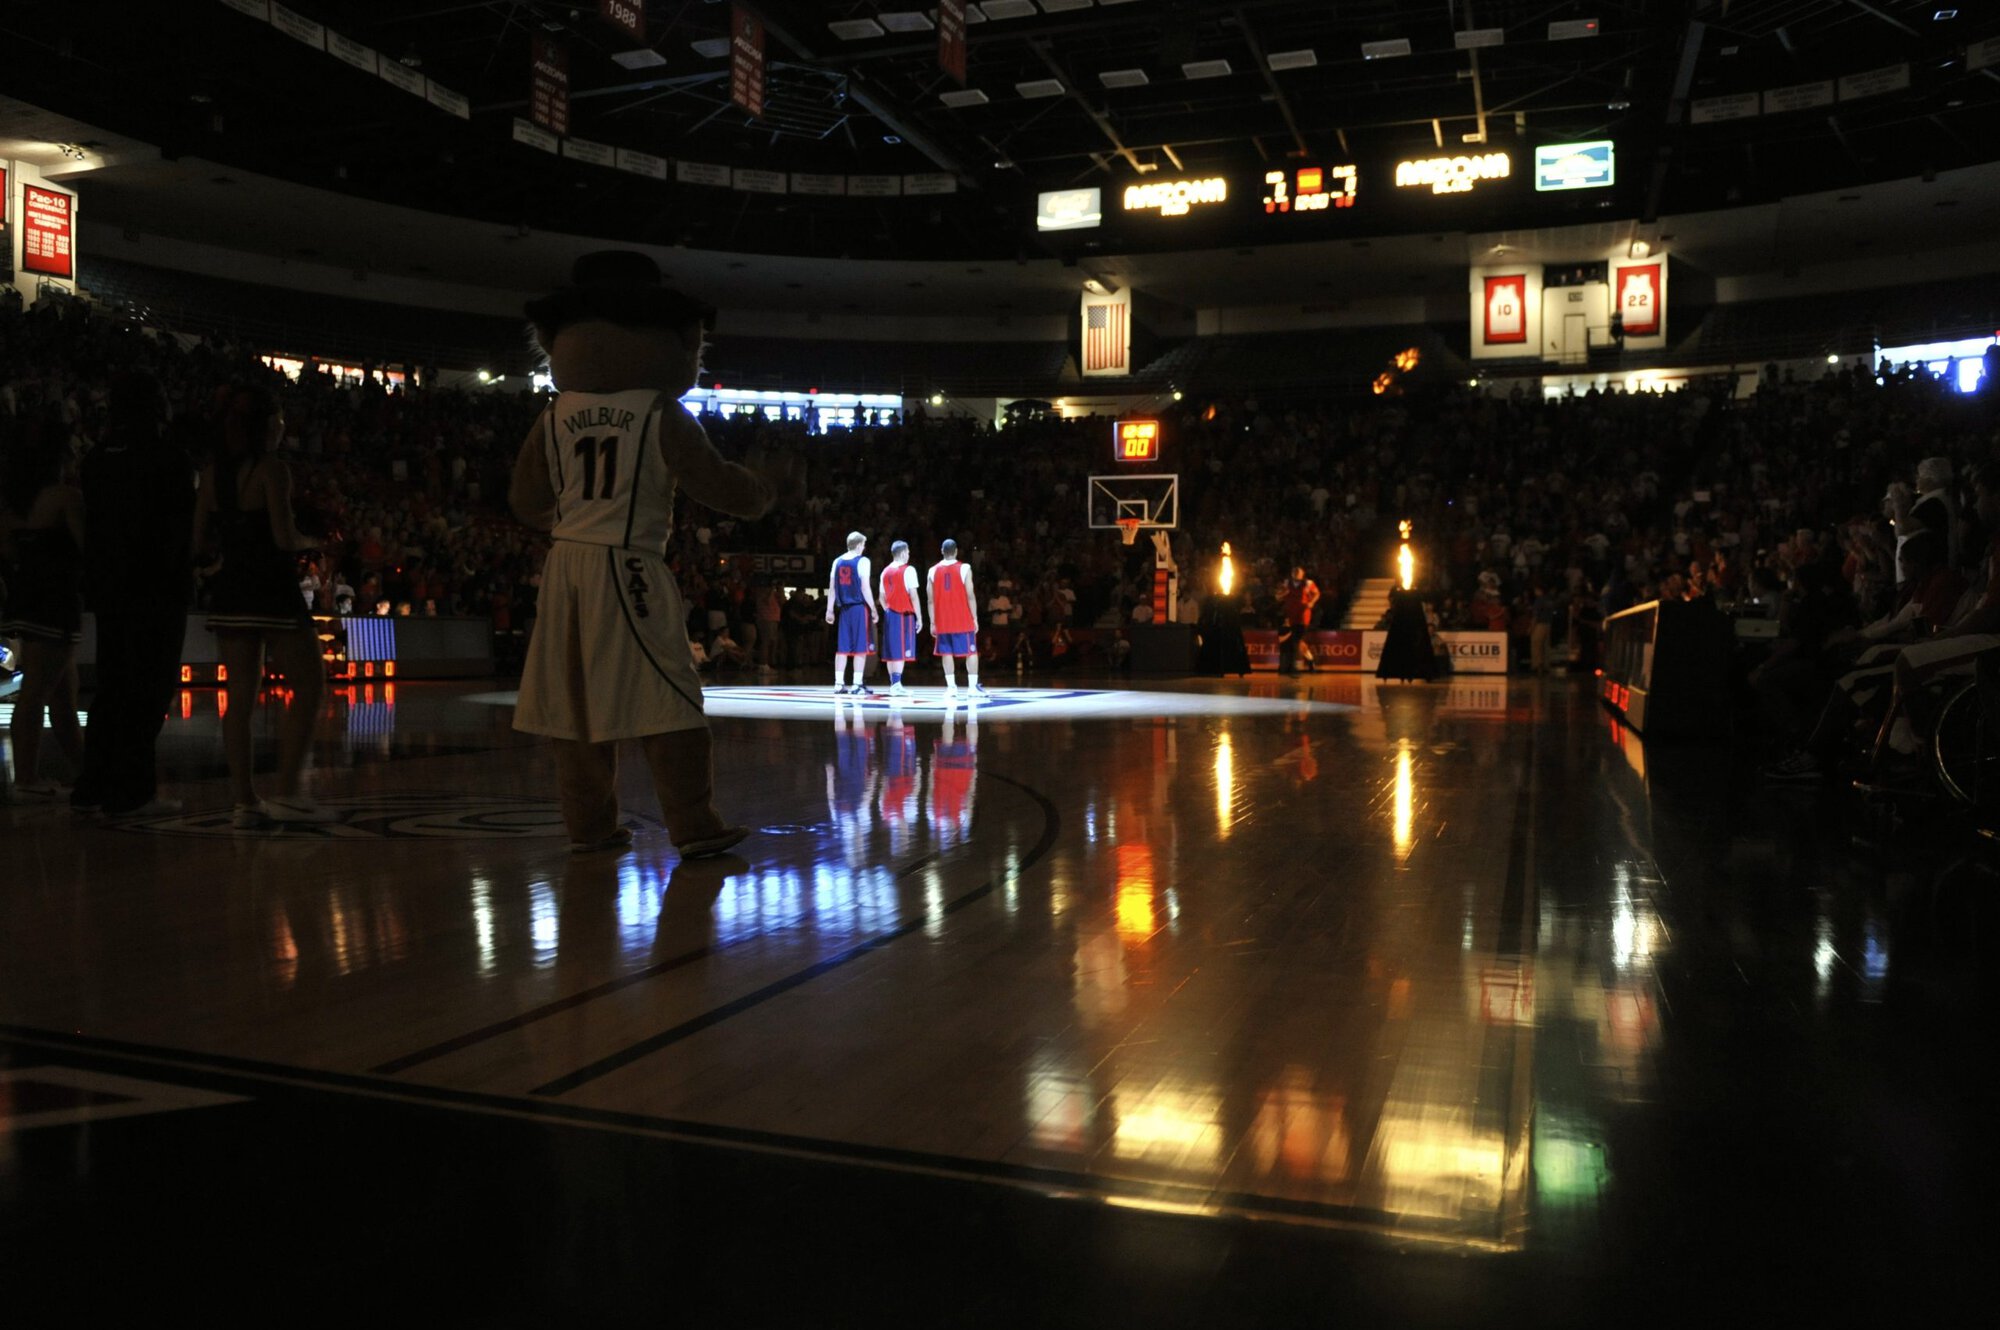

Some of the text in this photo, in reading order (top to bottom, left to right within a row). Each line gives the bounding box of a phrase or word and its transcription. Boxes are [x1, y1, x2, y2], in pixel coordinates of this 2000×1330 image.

[609, 0, 637, 28] 1988
[29, 190, 66, 208] Pac-10
[1628, 294, 1648, 307] 22
[1498, 304, 1512, 316] 10
[563, 407, 635, 433] WILBUR
[574, 436, 618, 501] 11
[752, 555, 807, 571] EICO
[625, 558, 649, 618] CATS
[1246, 643, 1280, 656] ELL
[1310, 643, 1357, 657] ARGO
[1451, 644, 1500, 656] TCLUB
